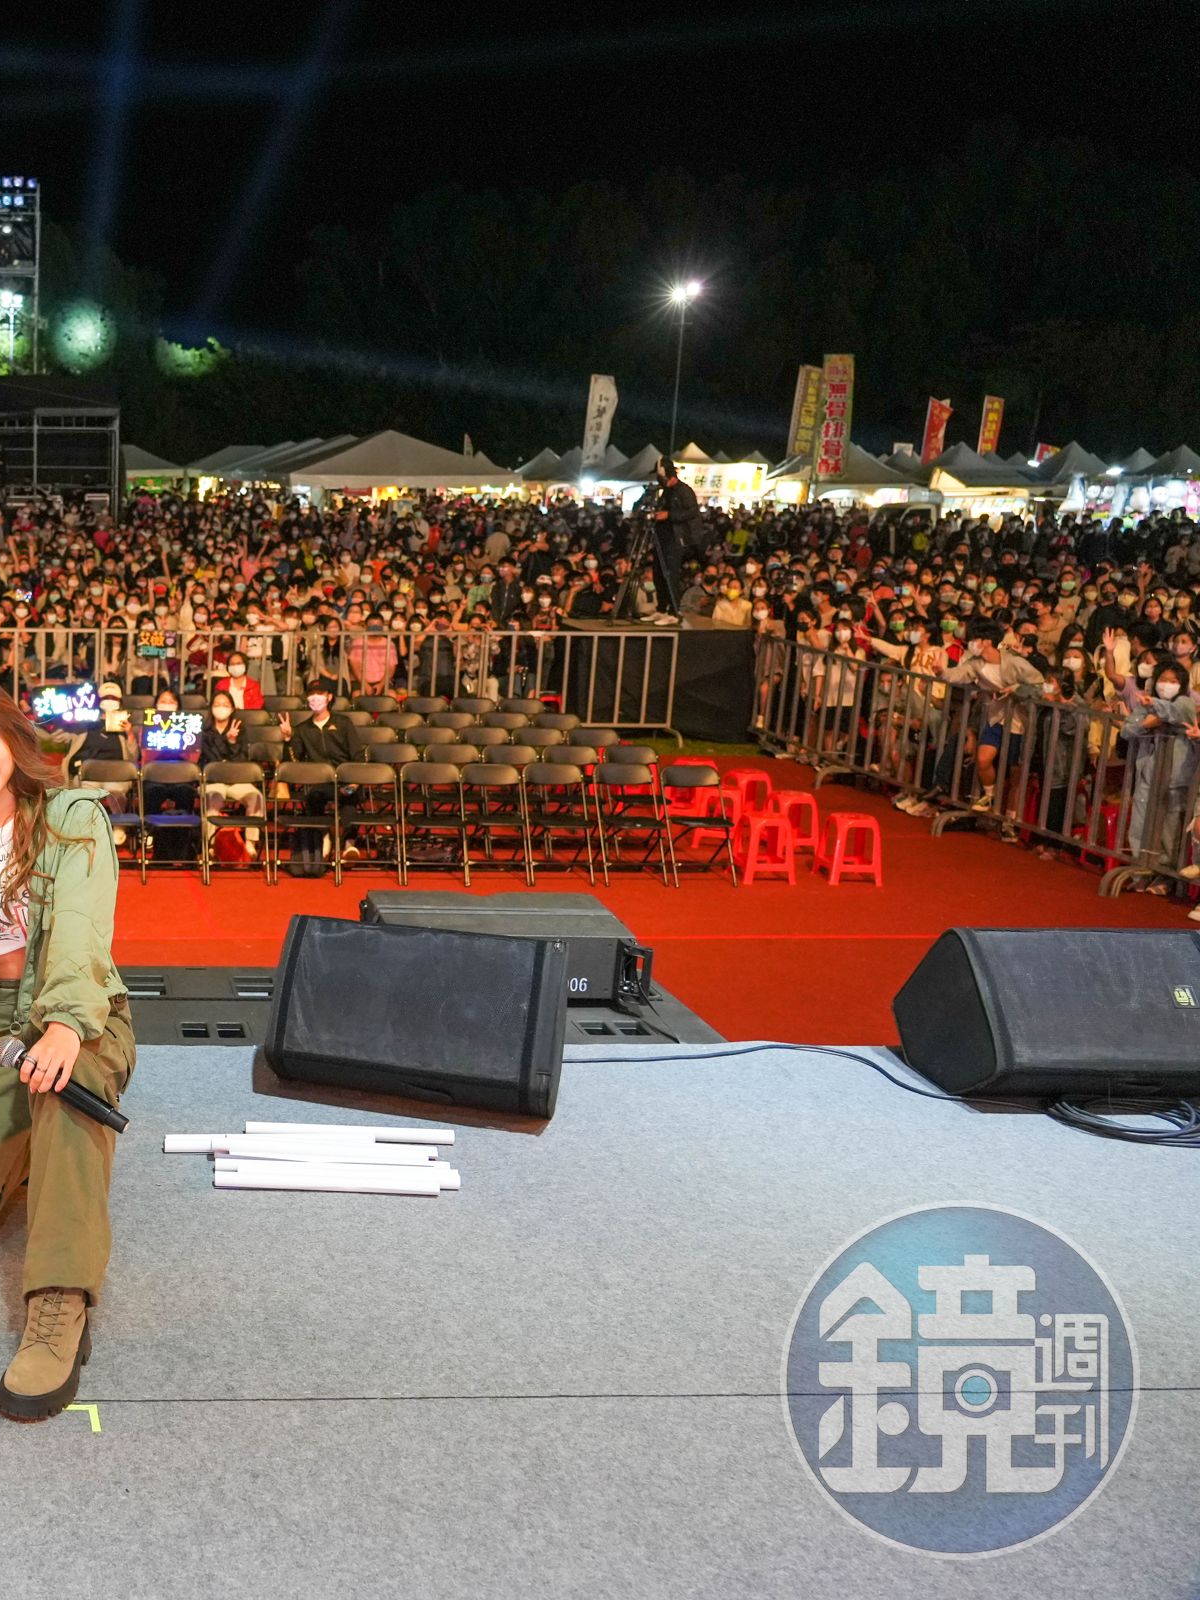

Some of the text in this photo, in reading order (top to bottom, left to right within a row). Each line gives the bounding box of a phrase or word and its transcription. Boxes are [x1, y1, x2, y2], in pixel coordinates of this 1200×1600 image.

[817, 382, 849, 475] 無骨排骨酥
[567, 977, 588, 992] 06
